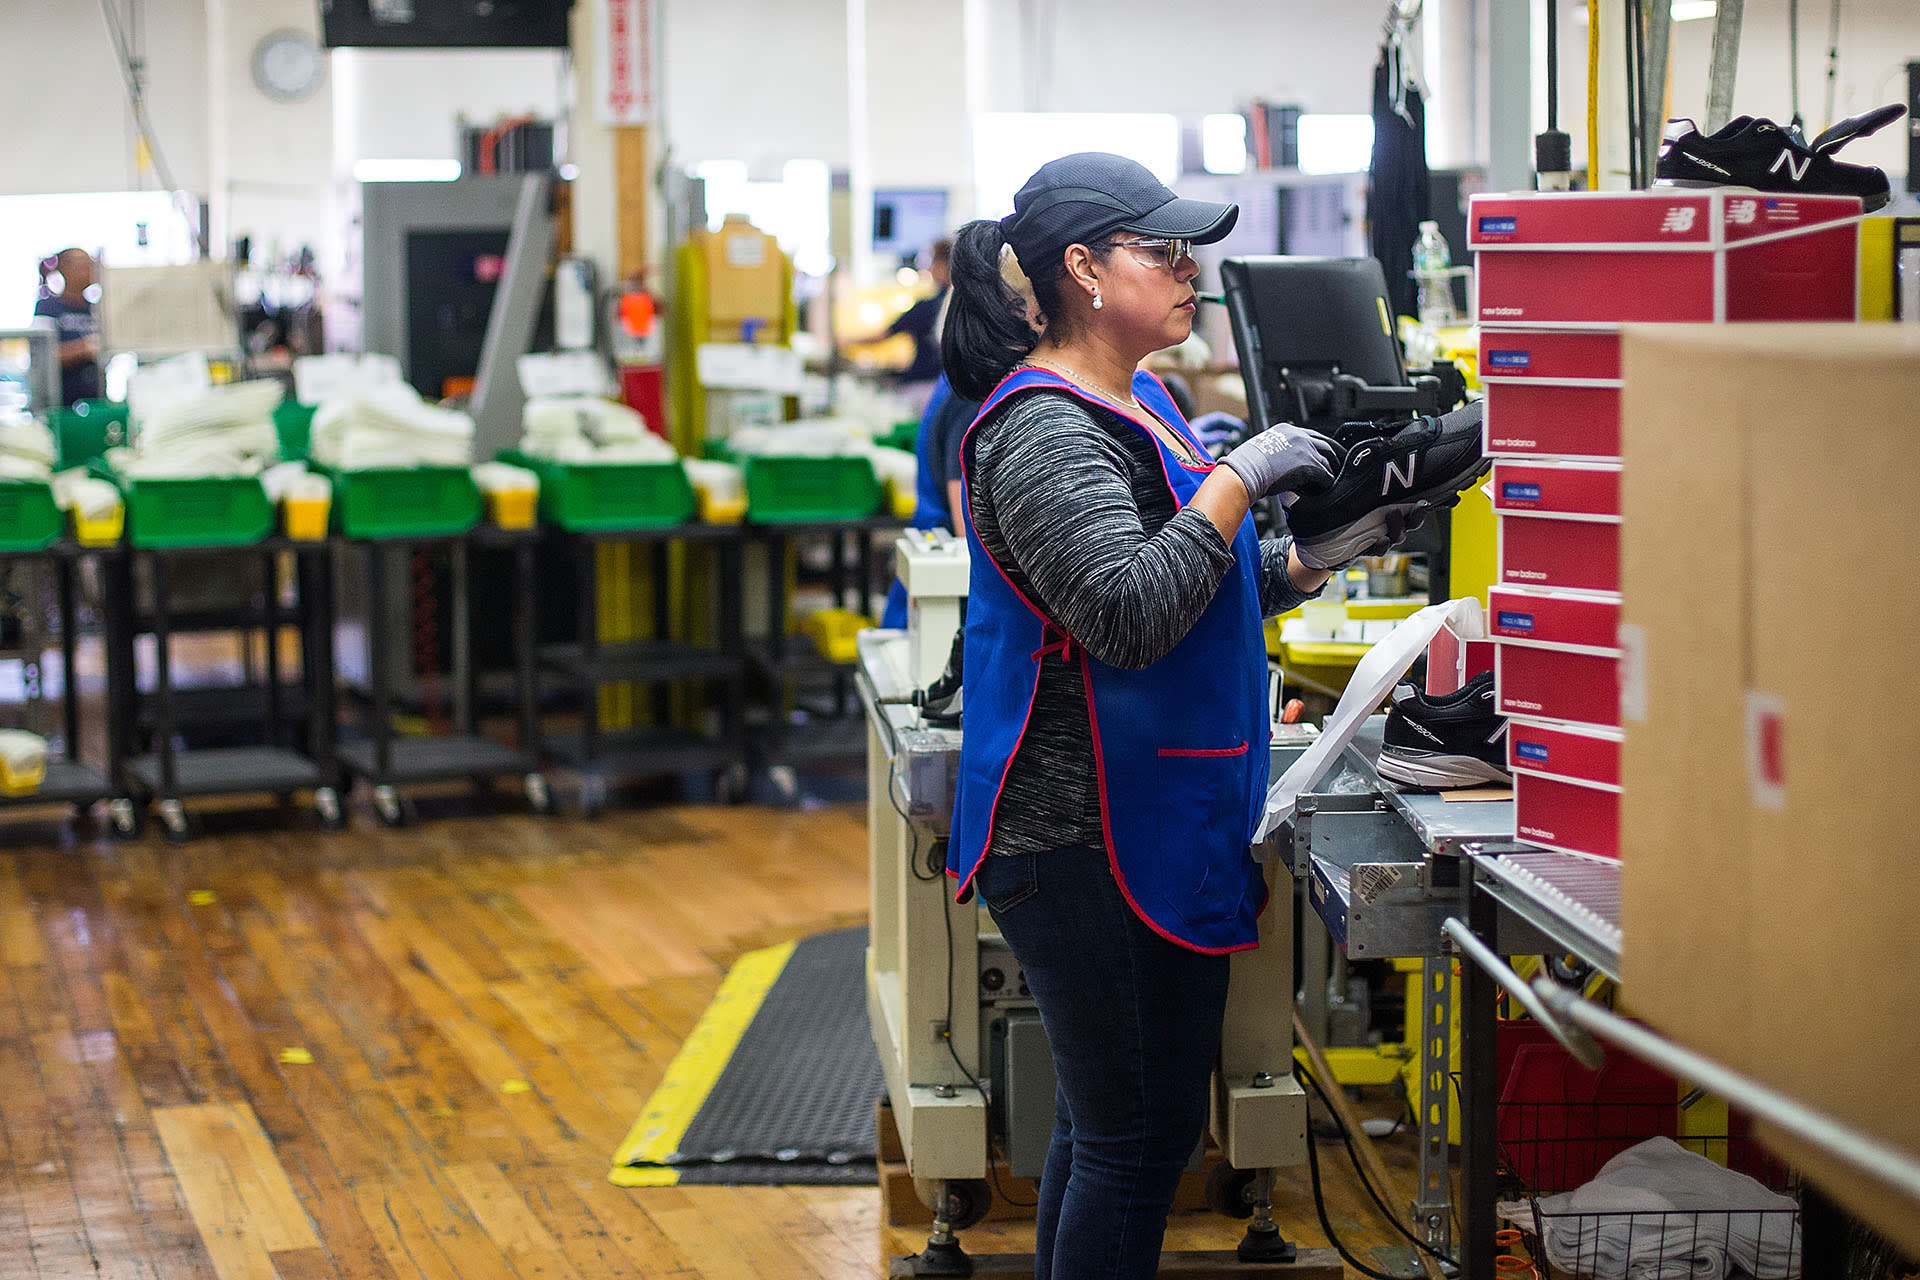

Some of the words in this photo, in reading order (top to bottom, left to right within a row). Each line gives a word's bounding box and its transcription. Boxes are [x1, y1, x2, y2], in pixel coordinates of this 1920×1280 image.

[1697, 157, 1718, 170] 990
[1768, 148, 1811, 181] N
[1507, 437, 1537, 447] balance
[1380, 450, 1418, 497] N
[1520, 569, 1547, 580] balance
[1516, 699, 1542, 710] balance
[1413, 724, 1431, 737] 990
